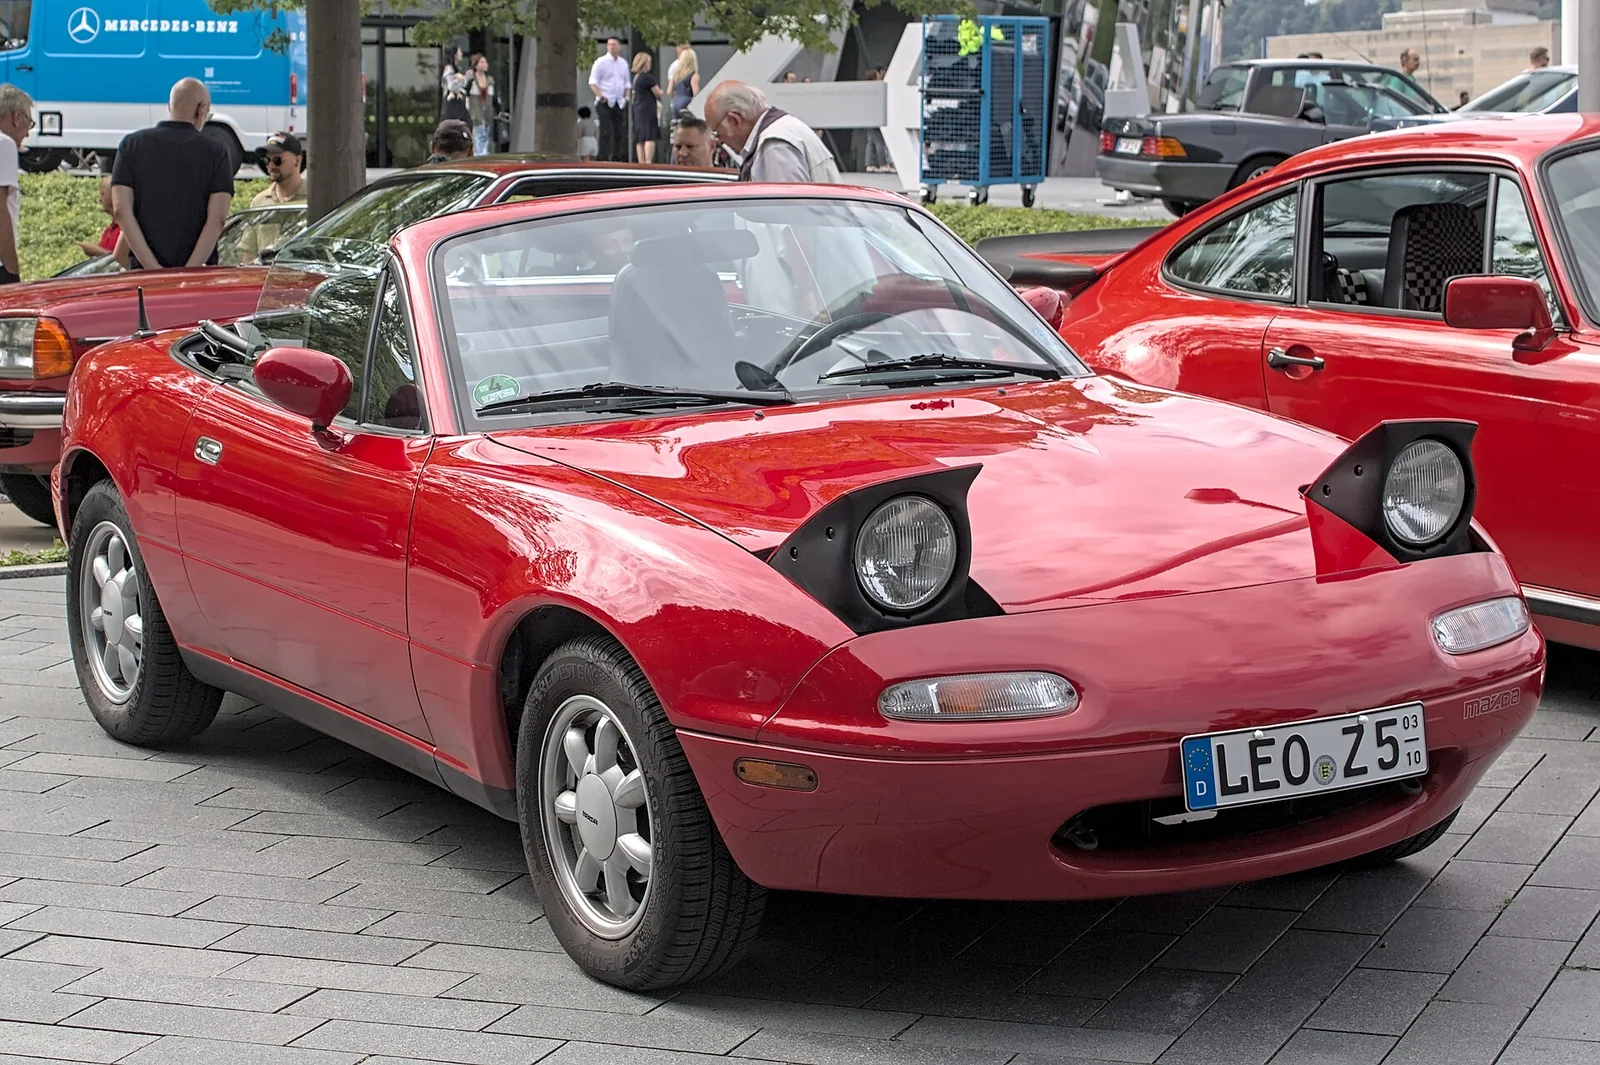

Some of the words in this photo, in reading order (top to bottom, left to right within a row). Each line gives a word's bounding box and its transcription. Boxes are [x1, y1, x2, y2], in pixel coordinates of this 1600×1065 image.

[1402, 714, 1419, 730] 03
[1216, 733, 1311, 797] LEO
[1341, 717, 1400, 778] Z5
[1406, 750, 1422, 766] 10
[1196, 780, 1207, 796] D
